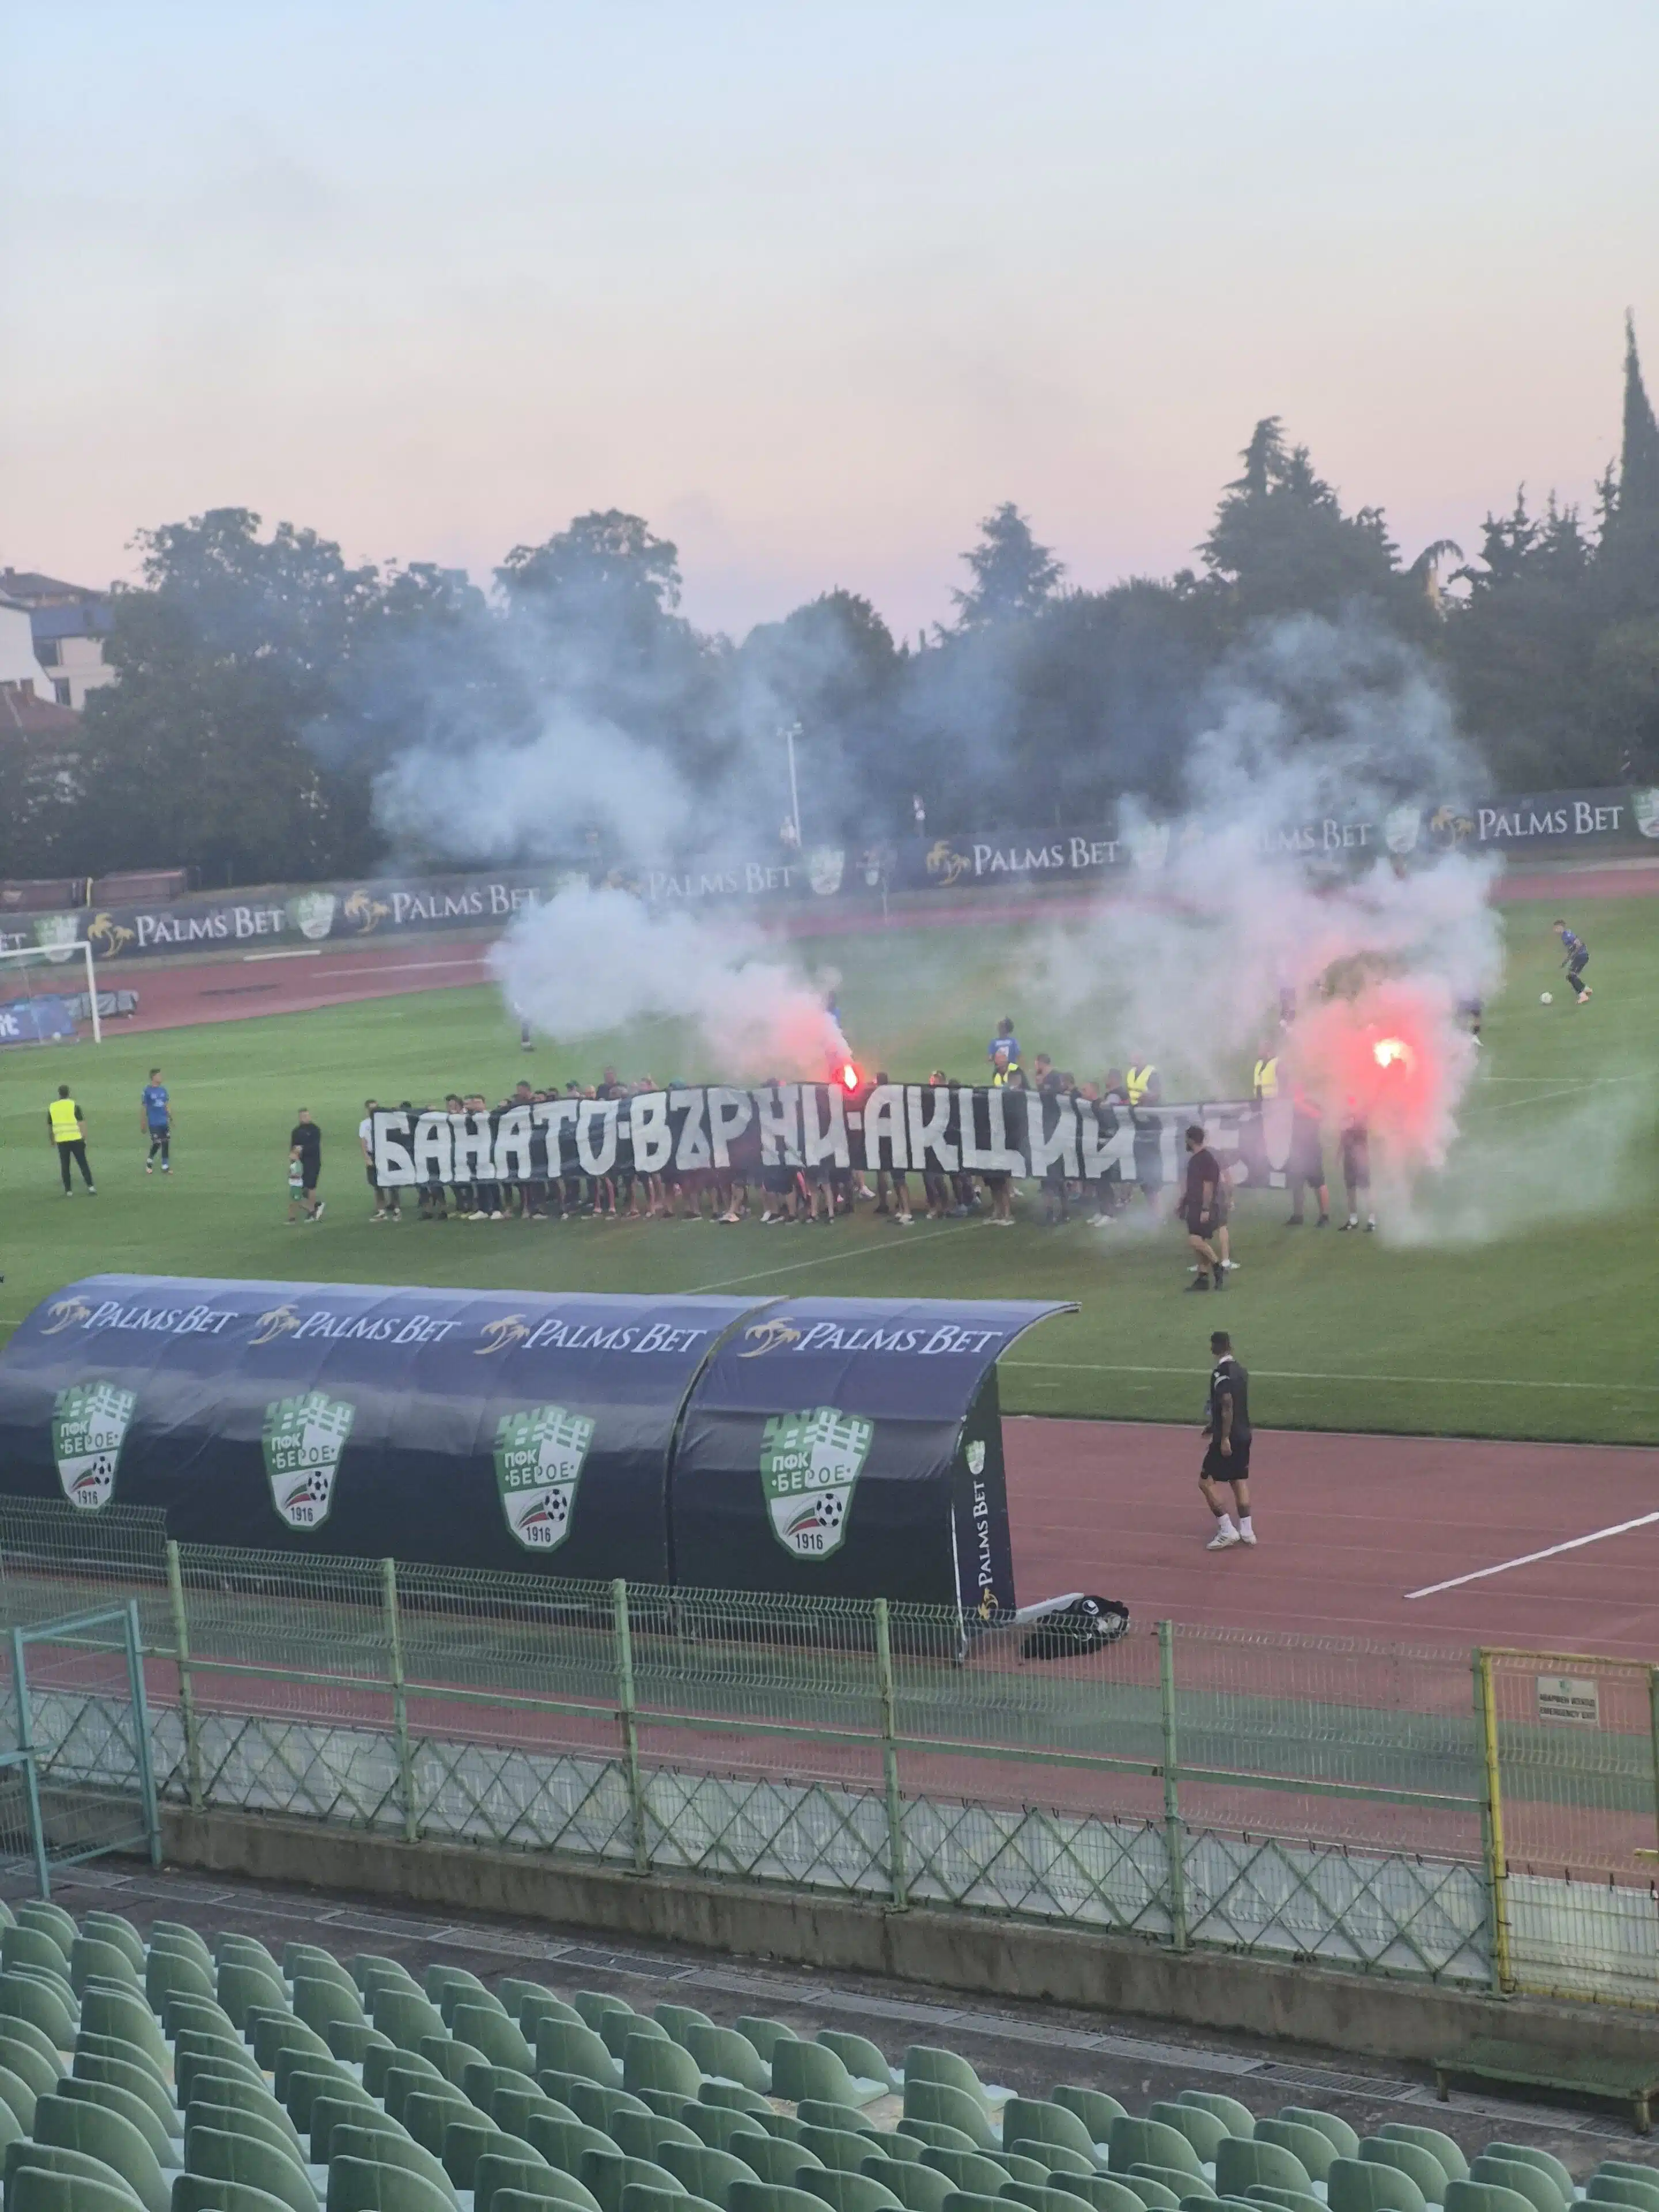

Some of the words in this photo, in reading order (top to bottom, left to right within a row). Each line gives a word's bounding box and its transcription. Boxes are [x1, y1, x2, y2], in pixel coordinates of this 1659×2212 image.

[1323, 819, 1372, 850] BET
[1479, 808, 1567, 840] PALMS
[1573, 801, 1624, 835] BET
[973, 844, 1063, 876] PALMS
[1069, 837, 1119, 868] BET
[648, 872, 738, 900] PALMS
[746, 862, 797, 894] BET
[389, 892, 483, 923] PALMS
[488, 884, 541, 915] BET
[135, 915, 229, 946] PALMS
[232, 906, 285, 938] BET
[81, 1301, 183, 1330] PALMS
[175, 1305, 238, 1334] BET
[290, 1311, 394, 1340] PALMS
[390, 1314, 462, 1344] BET
[520, 1319, 635, 1350] PALMS
[631, 1323, 707, 1354] BET
[792, 1322, 925, 1352] PALMS
[918, 1325, 1003, 1355] BET
[60, 1420, 88, 1436] ПФК
[271, 1434, 301, 1450] ПФК
[504, 1450, 537, 1468] ПФК
[772, 1452, 809, 1471] ПФК
[77, 1490, 99, 1505] 1916
[290, 1506, 314, 1522] 1916
[973, 1480, 988, 1518] BET
[525, 1525, 551, 1543] 1916
[794, 1533, 823, 1551] 1916
[978, 1520, 993, 1586] PALMS
